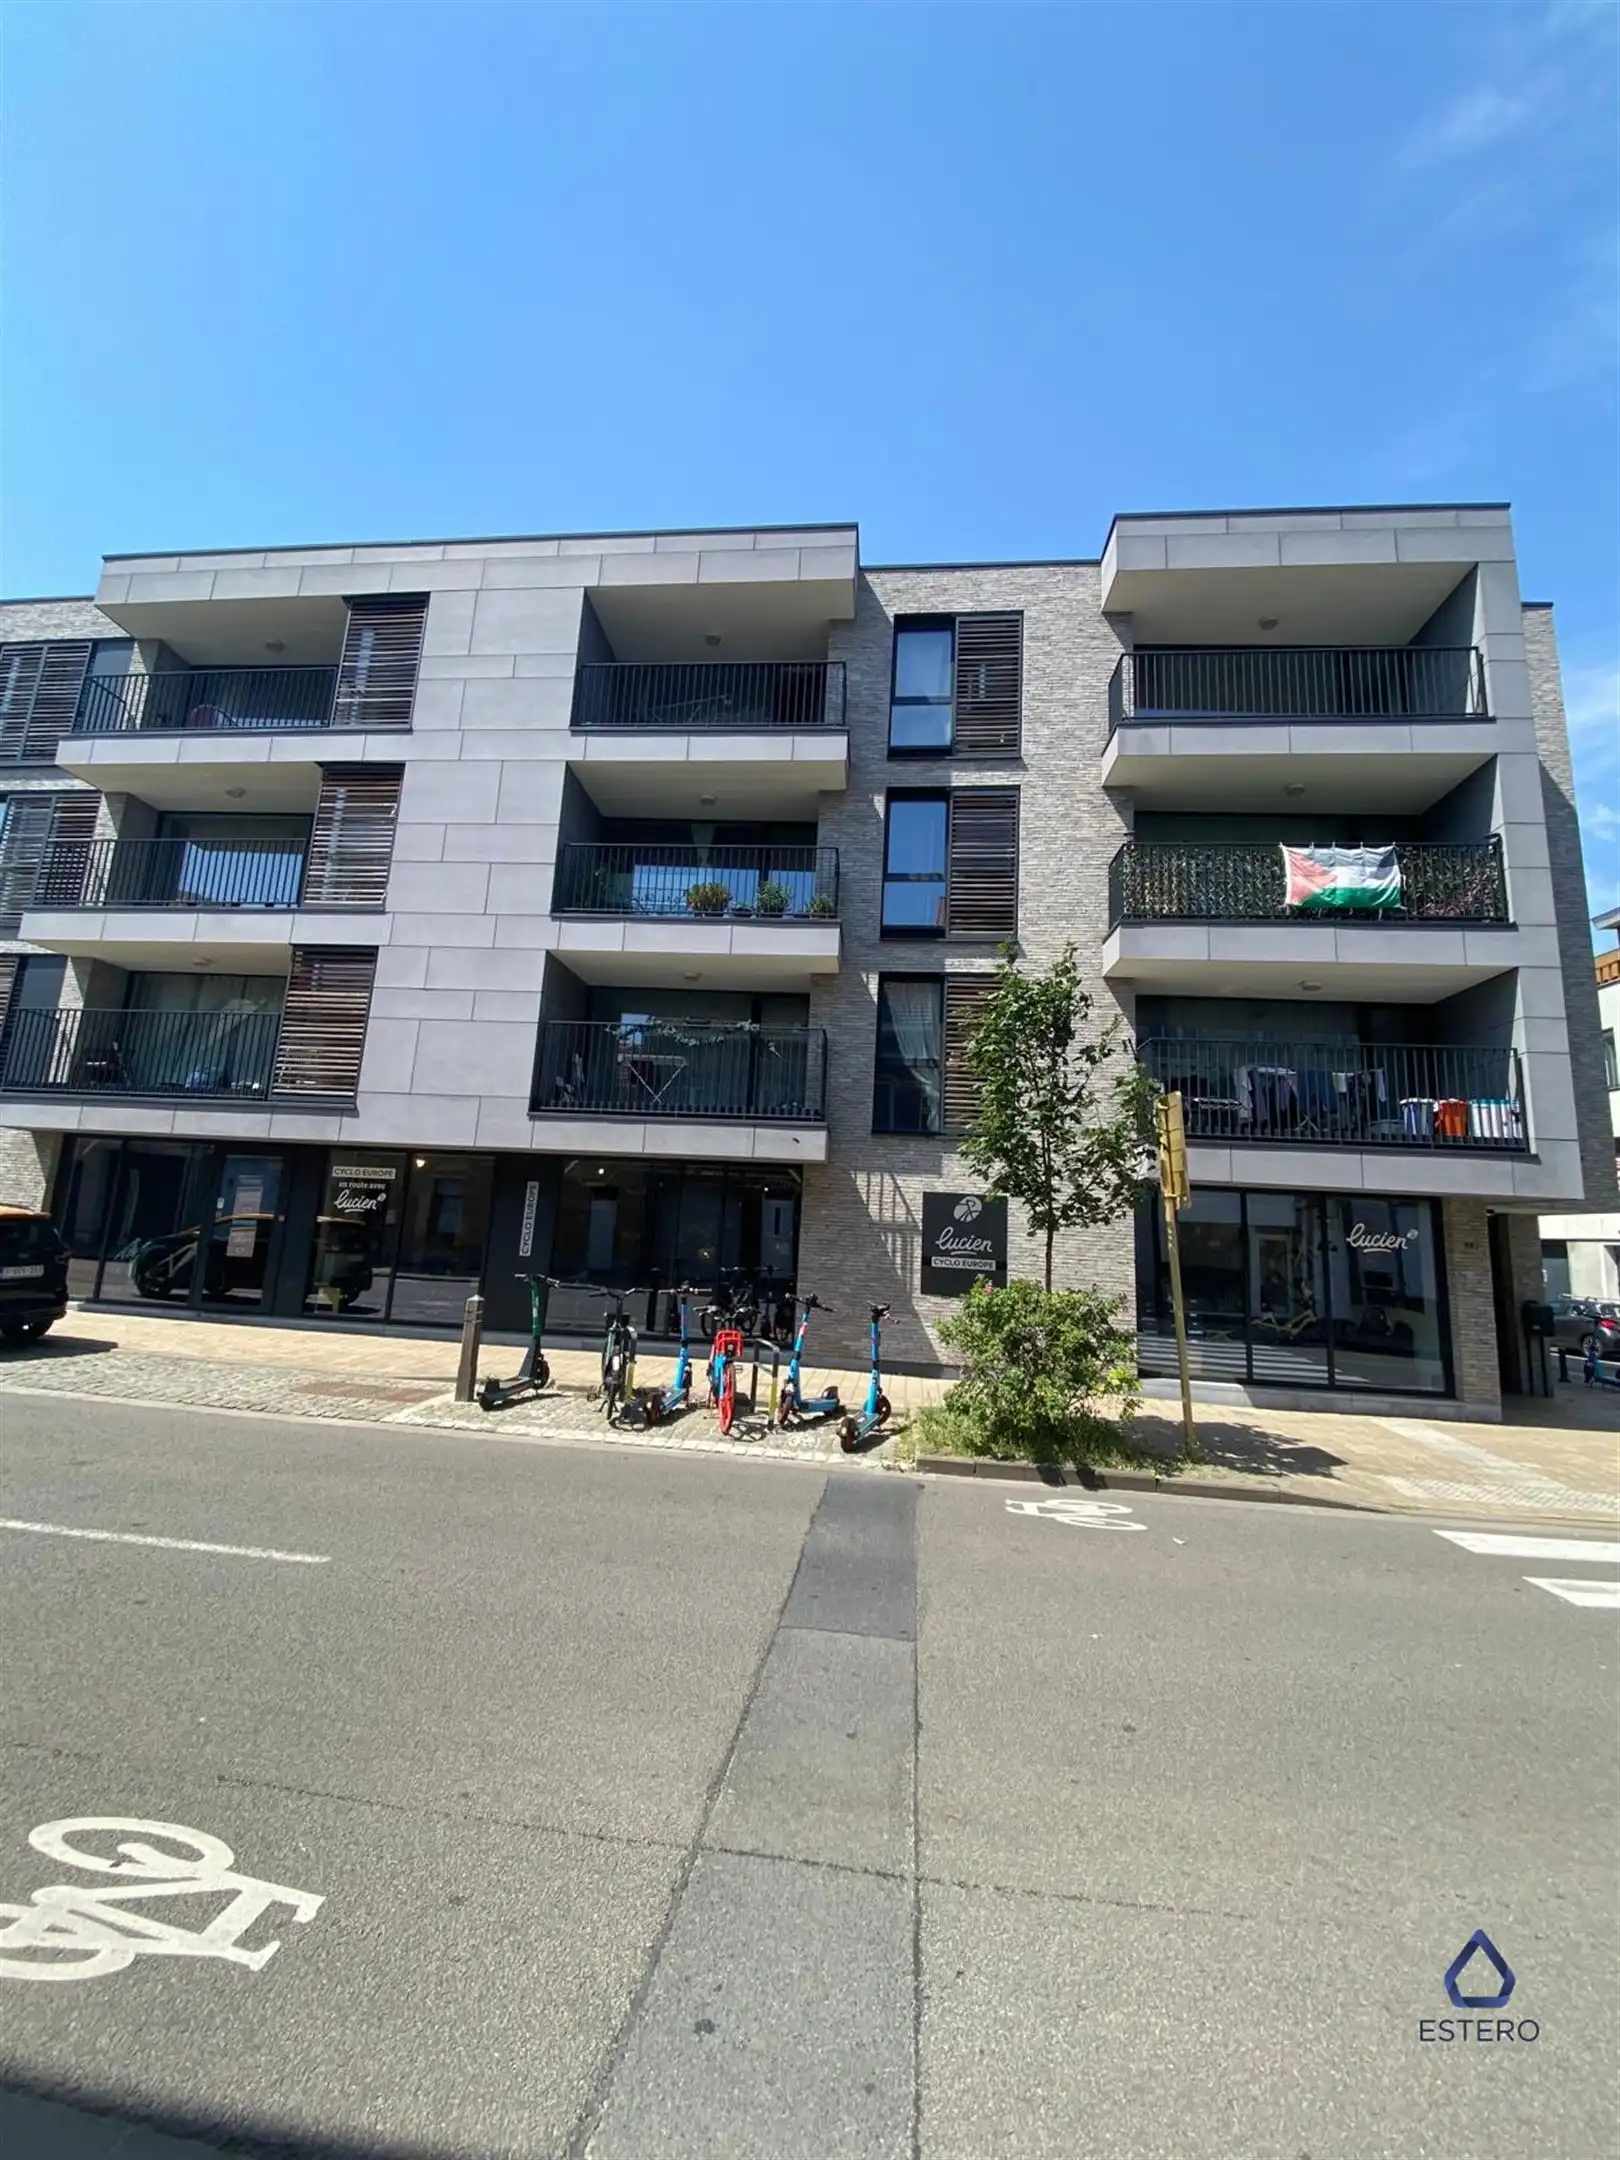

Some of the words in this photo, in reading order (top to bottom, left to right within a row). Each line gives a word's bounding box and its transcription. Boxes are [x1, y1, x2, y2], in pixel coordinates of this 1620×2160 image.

[334, 1168, 361, 1176] CYCLO
[362, 1168, 394, 1178] EUROPE
[525, 1184, 538, 1220] EUROPE
[521, 1222, 533, 1254] CYCLO
[933, 1258, 960, 1266] CYCLO
[962, 1259, 994, 1269] EUROPE
